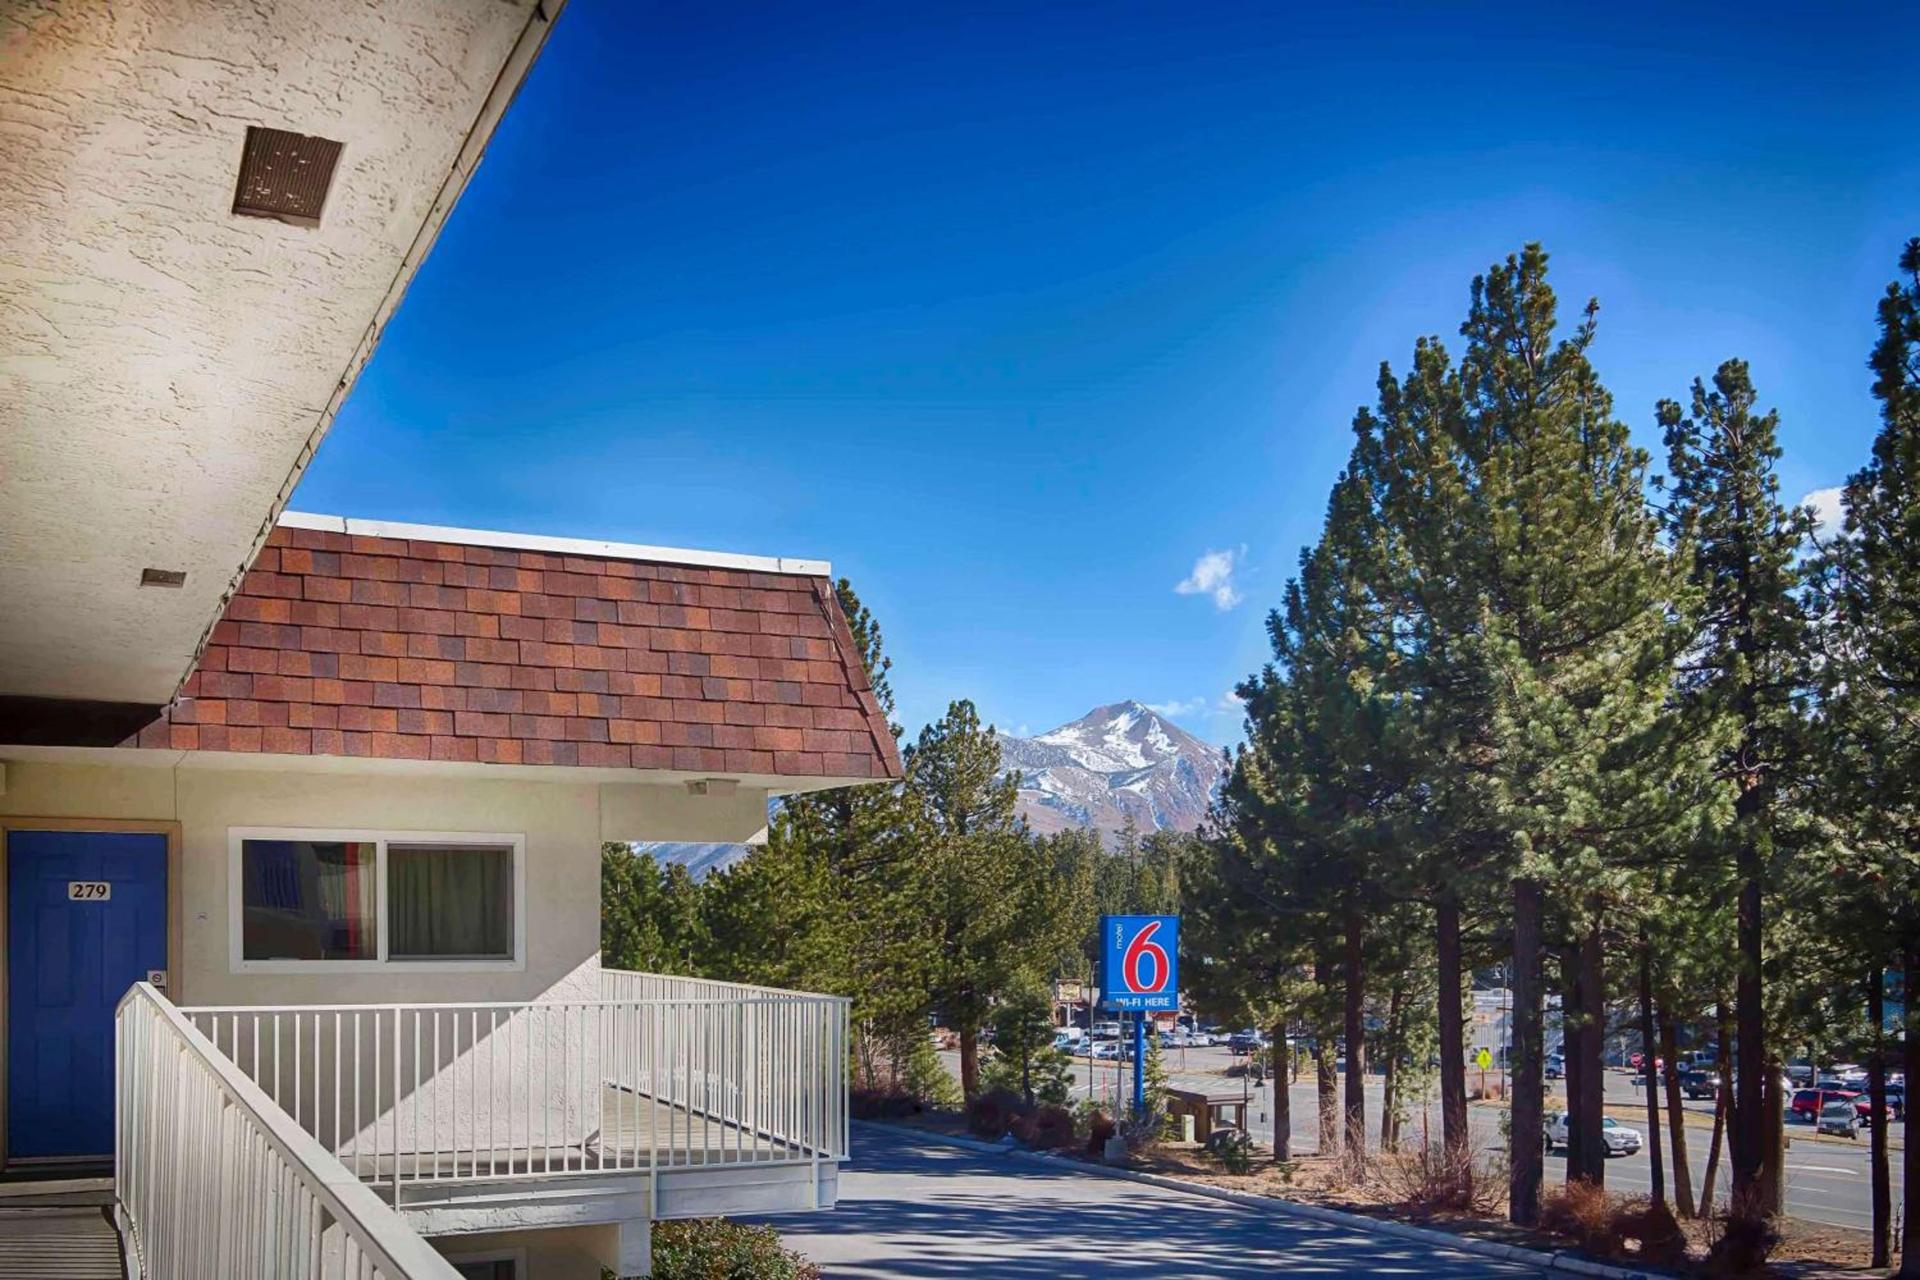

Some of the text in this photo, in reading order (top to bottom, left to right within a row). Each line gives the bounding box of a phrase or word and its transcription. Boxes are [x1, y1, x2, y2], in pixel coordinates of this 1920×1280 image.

[73, 884, 107, 898] 279
[1122, 921, 1170, 993] 6
[1145, 997, 1170, 1007] HERE
